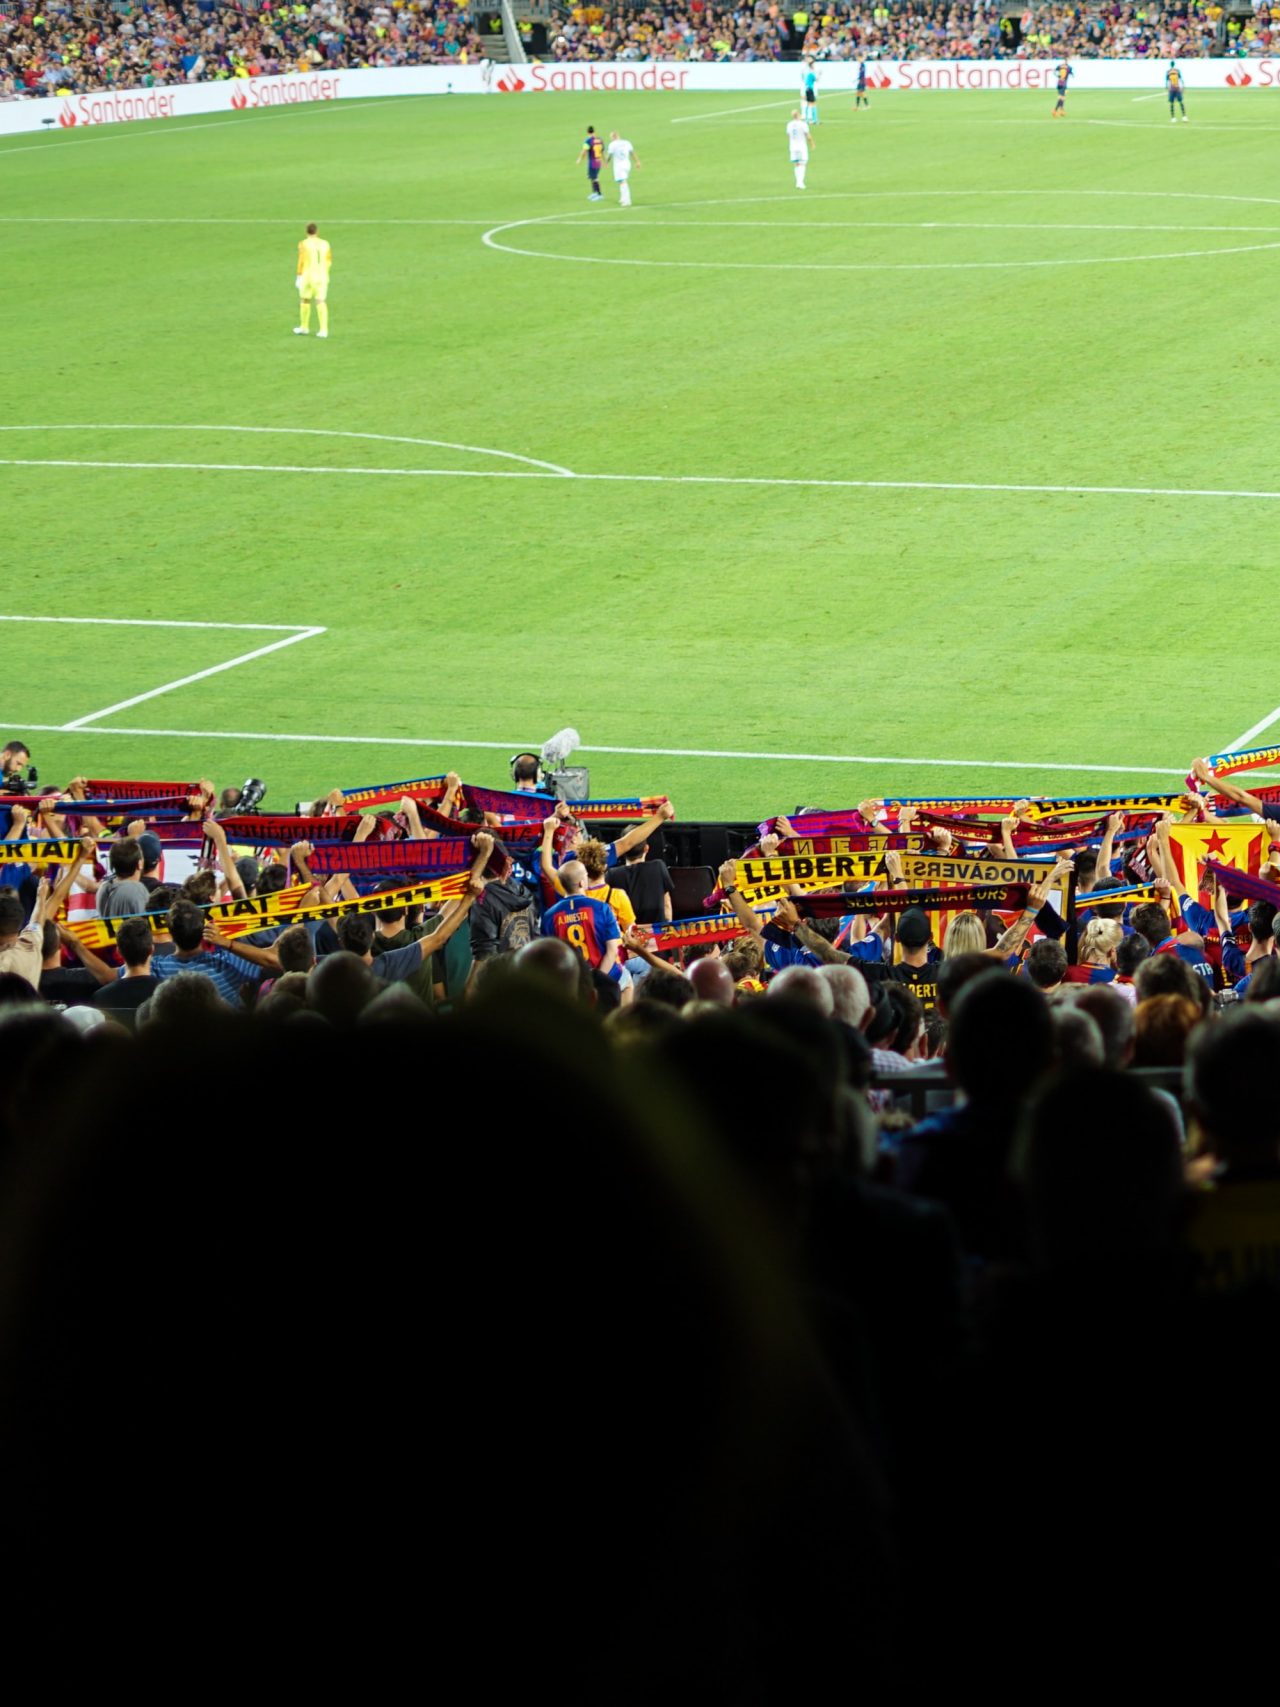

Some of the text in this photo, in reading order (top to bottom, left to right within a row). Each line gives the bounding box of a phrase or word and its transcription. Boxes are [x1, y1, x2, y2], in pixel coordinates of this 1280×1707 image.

[248, 73, 341, 108] Santander
[530, 65, 689, 92] Santander
[898, 63, 1052, 89] Santander
[78, 90, 176, 127] Santander
[567, 923, 590, 961] 8
